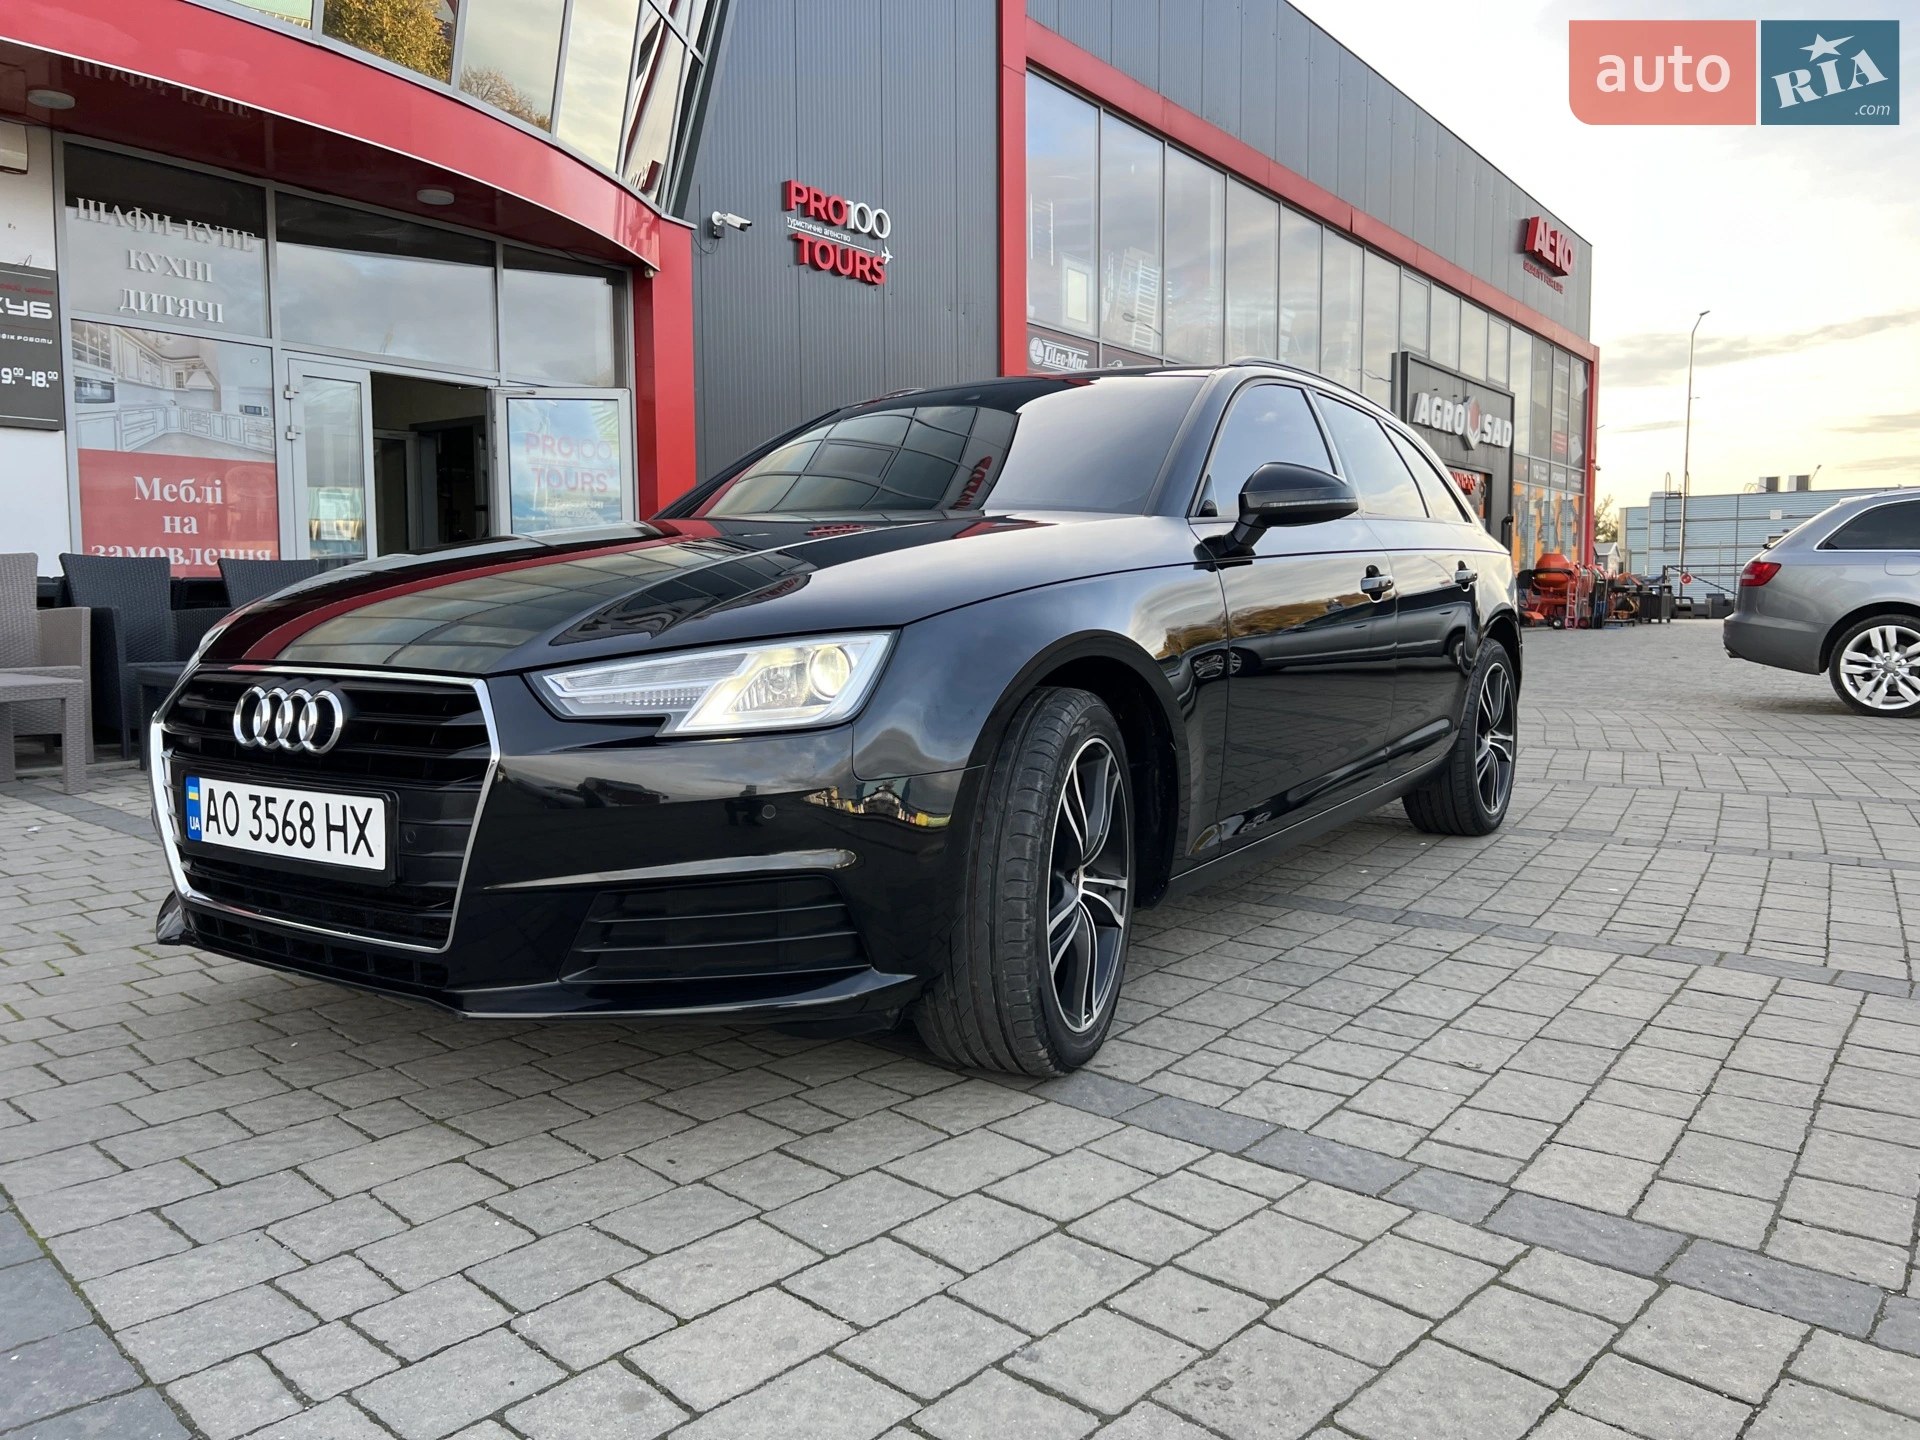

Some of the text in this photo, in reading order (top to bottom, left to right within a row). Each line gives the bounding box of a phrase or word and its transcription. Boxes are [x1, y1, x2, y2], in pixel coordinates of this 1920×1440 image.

[76, 197, 254, 252] ШАФИ-КУПЕ
[786, 180, 891, 239] PRO100
[128, 249, 213, 283] КУХНІ
[792, 232, 886, 285] TOURS
[118, 288, 224, 323] ДИТЯЧІ
[1413, 392, 1465, 435] AGRO
[1482, 413, 1512, 448] SAD
[525, 433, 612, 462] PRO100
[134, 476, 224, 505] Меблі
[531, 467, 608, 493] TOURS
[163, 515, 199, 535] на
[189, 816, 201, 831] UA
[205, 788, 375, 858] AO 3568 HX
